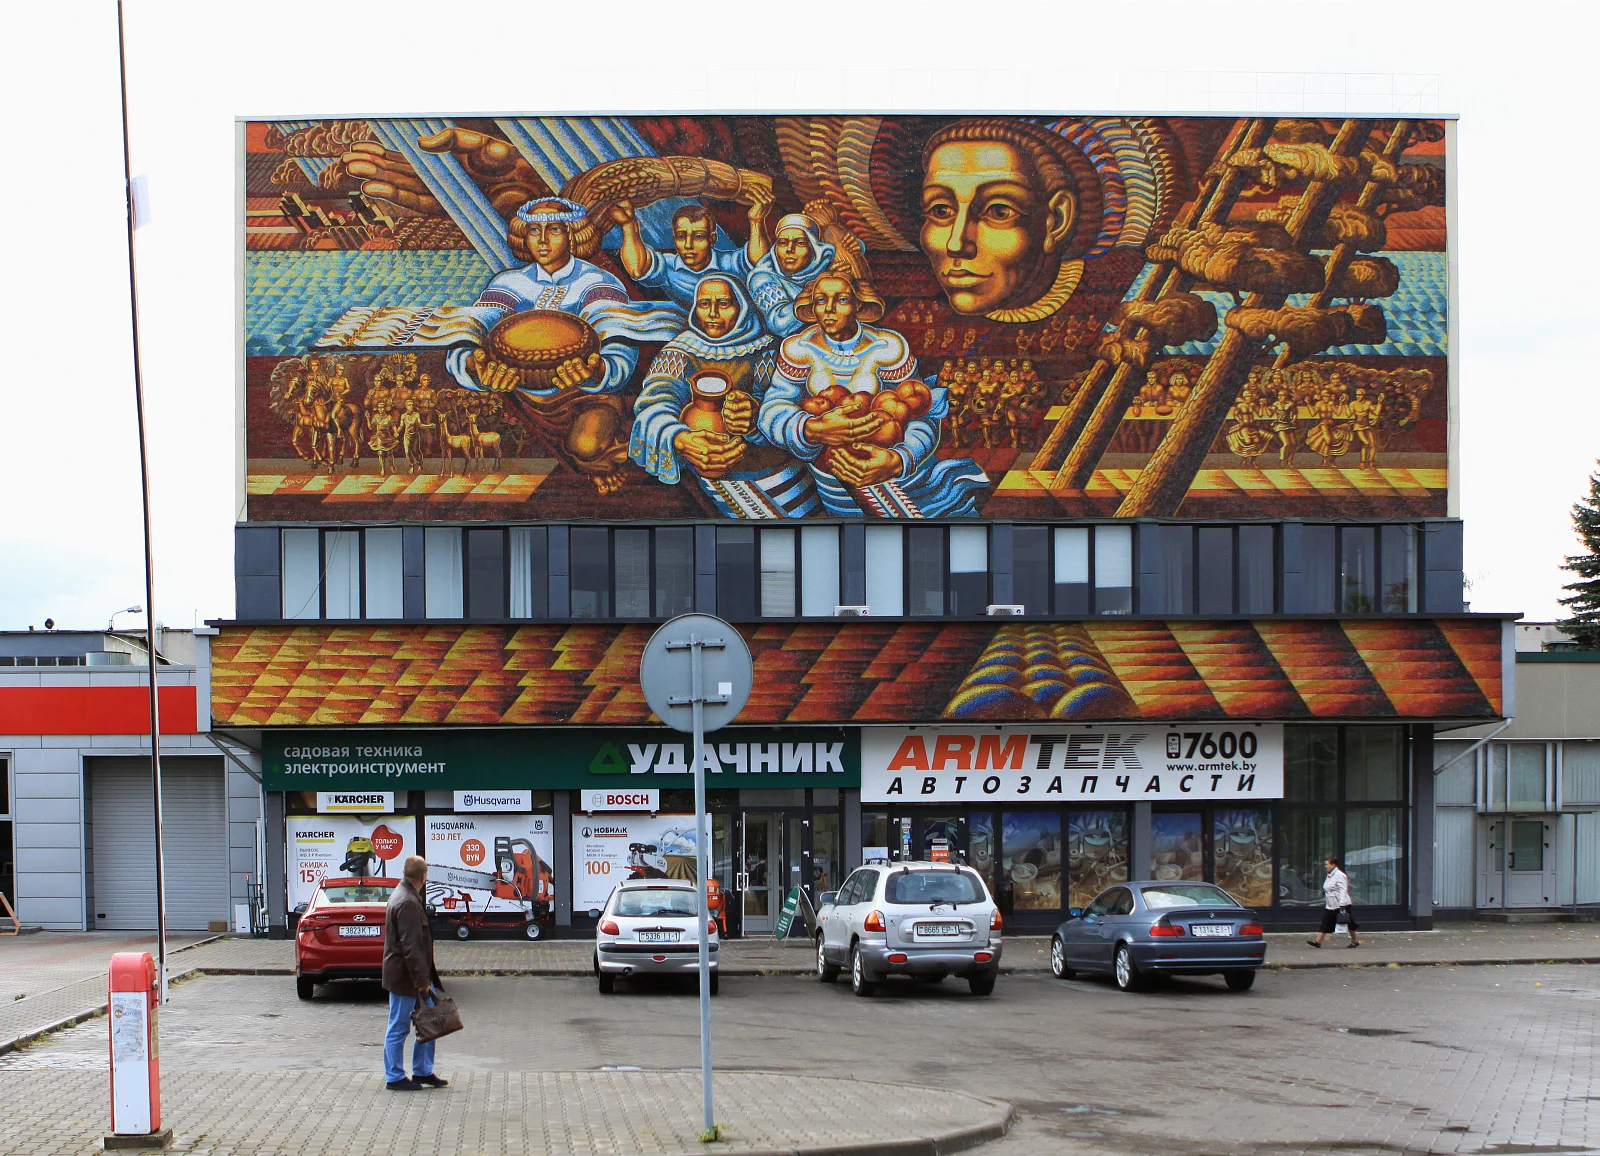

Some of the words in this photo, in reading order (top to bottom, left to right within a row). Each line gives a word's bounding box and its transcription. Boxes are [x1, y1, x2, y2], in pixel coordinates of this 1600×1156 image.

[1183, 731, 1257, 759] 7600
[284, 746, 350, 760] садовая
[356, 746, 423, 757] техника
[627, 743, 845, 774] УДАЧНИК
[887, 734, 1149, 771] ARMTEK
[284, 762, 446, 777] электроинструмент
[1166, 761, 1257, 772] www.armtek.by
[886, 774, 1255, 794] АВТОЗАПЧАСТИ
[334, 795, 385, 804] KÄRCHER
[474, 796, 521, 806] Husqvarna
[606, 794, 649, 805] BOSCH
[430, 822, 477, 830] HUSQVARNA.
[431, 833, 445, 841] 330
[585, 861, 611, 874] 100
[299, 869, 328, 883] 15%
[345, 926, 361, 934] 3823
